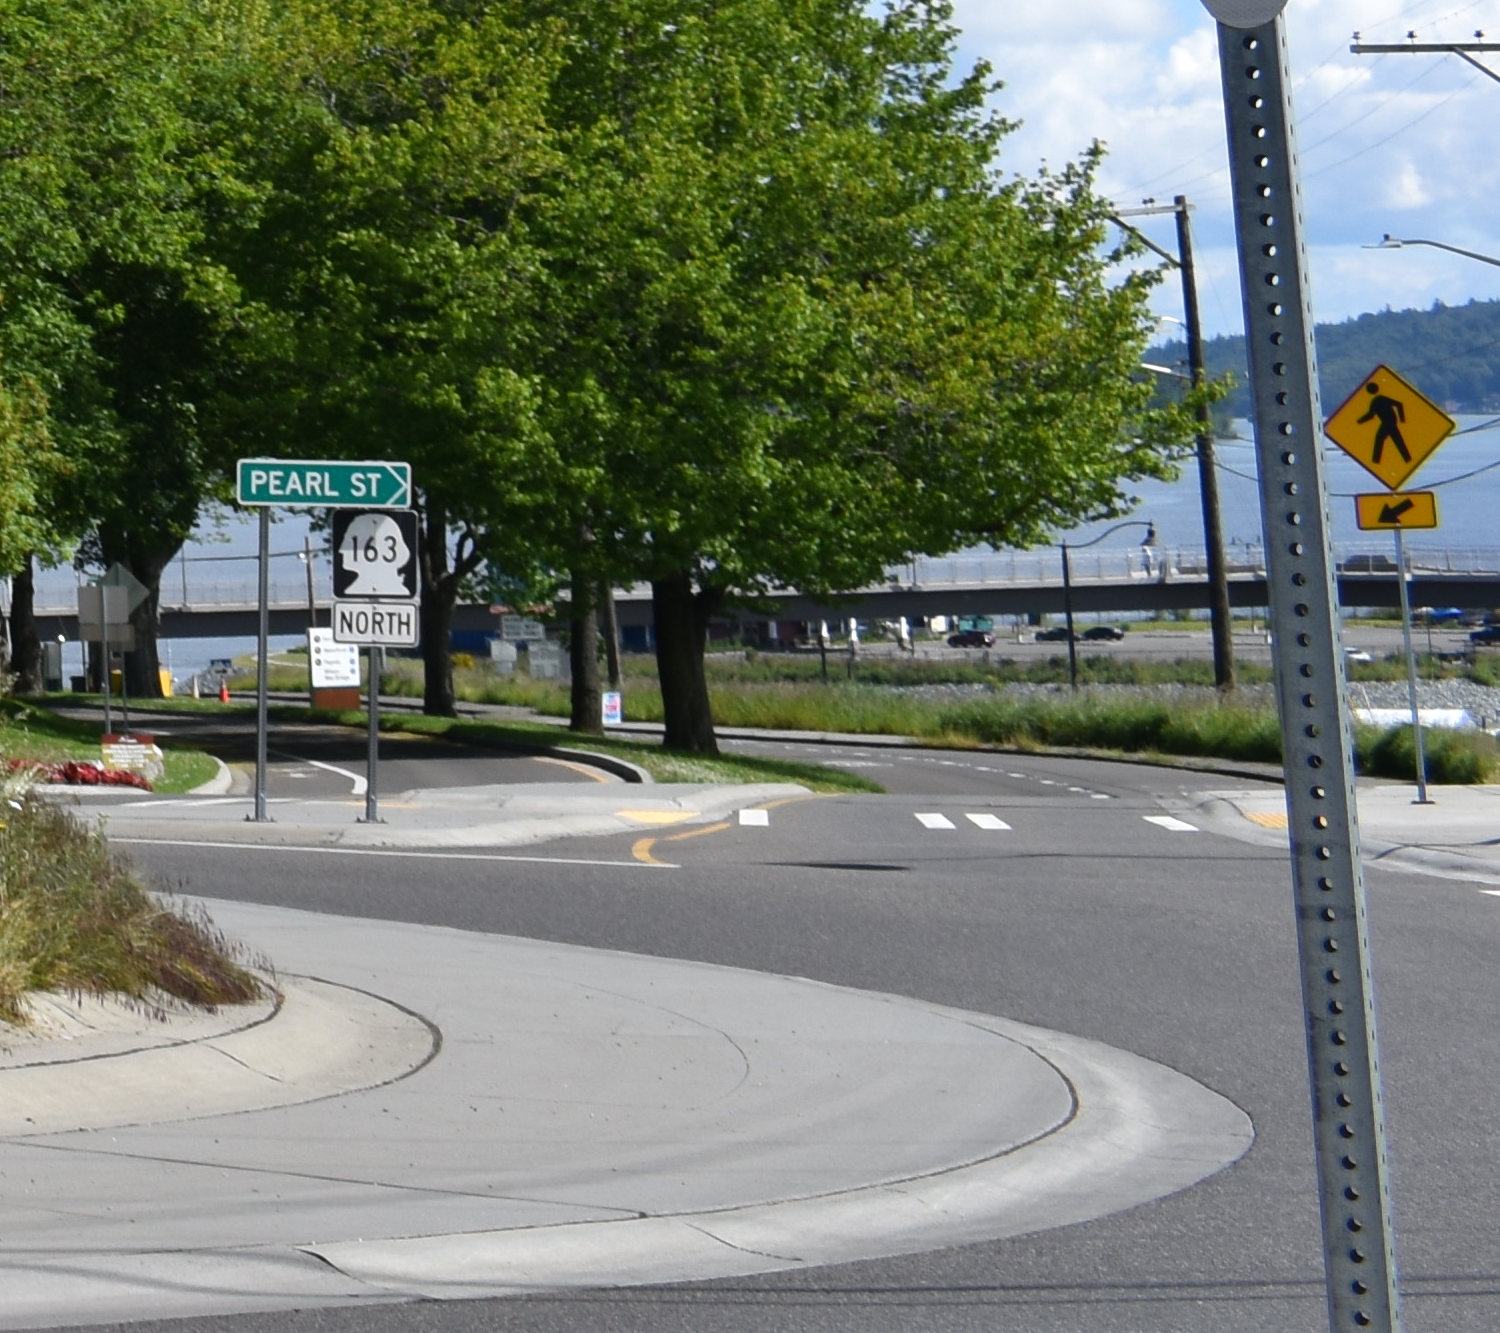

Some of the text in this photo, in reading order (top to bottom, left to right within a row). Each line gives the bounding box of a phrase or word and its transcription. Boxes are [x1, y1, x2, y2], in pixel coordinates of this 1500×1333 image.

[251, 470, 382, 497] PEARL ST
[351, 535, 398, 563] 163
[339, 611, 411, 636] NORTH
